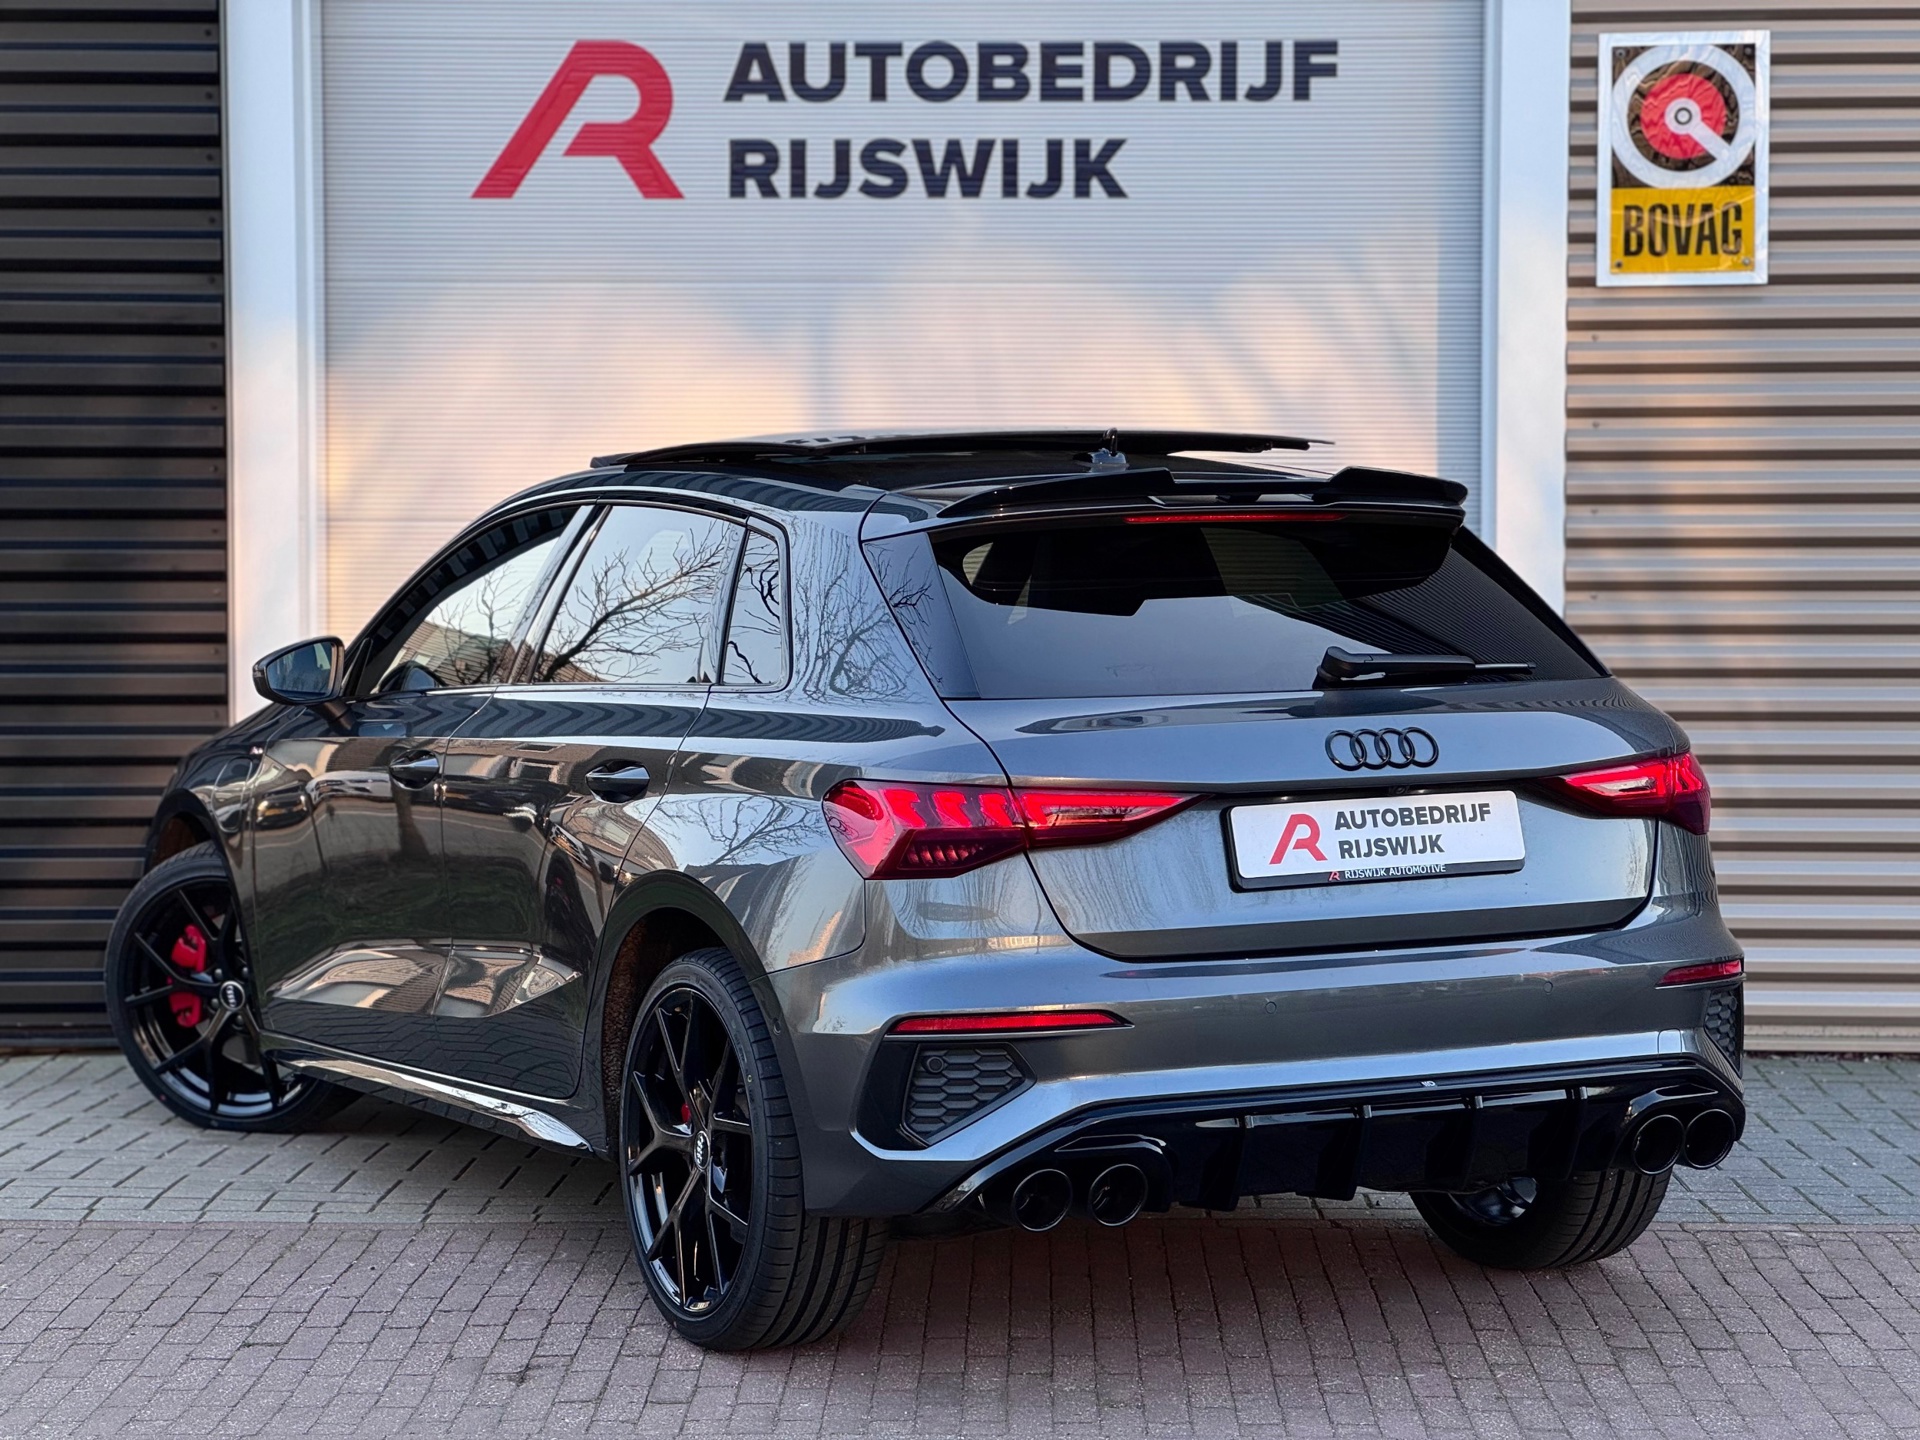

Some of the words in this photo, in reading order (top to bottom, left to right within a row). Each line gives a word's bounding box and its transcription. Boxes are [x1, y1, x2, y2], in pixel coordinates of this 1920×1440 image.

[724, 40, 1339, 103] AUTOBEDRIJF
[729, 138, 1128, 200] RIJSWIJK
[1623, 202, 1743, 258] BOVAG
[1334, 802, 1491, 831] AUTOBEDRIJF
[1338, 834, 1445, 860] RIJSWIJK
[1344, 867, 1387, 879] RIJSWIJK
[1389, 864, 1447, 877] AUTOMOTIVE
